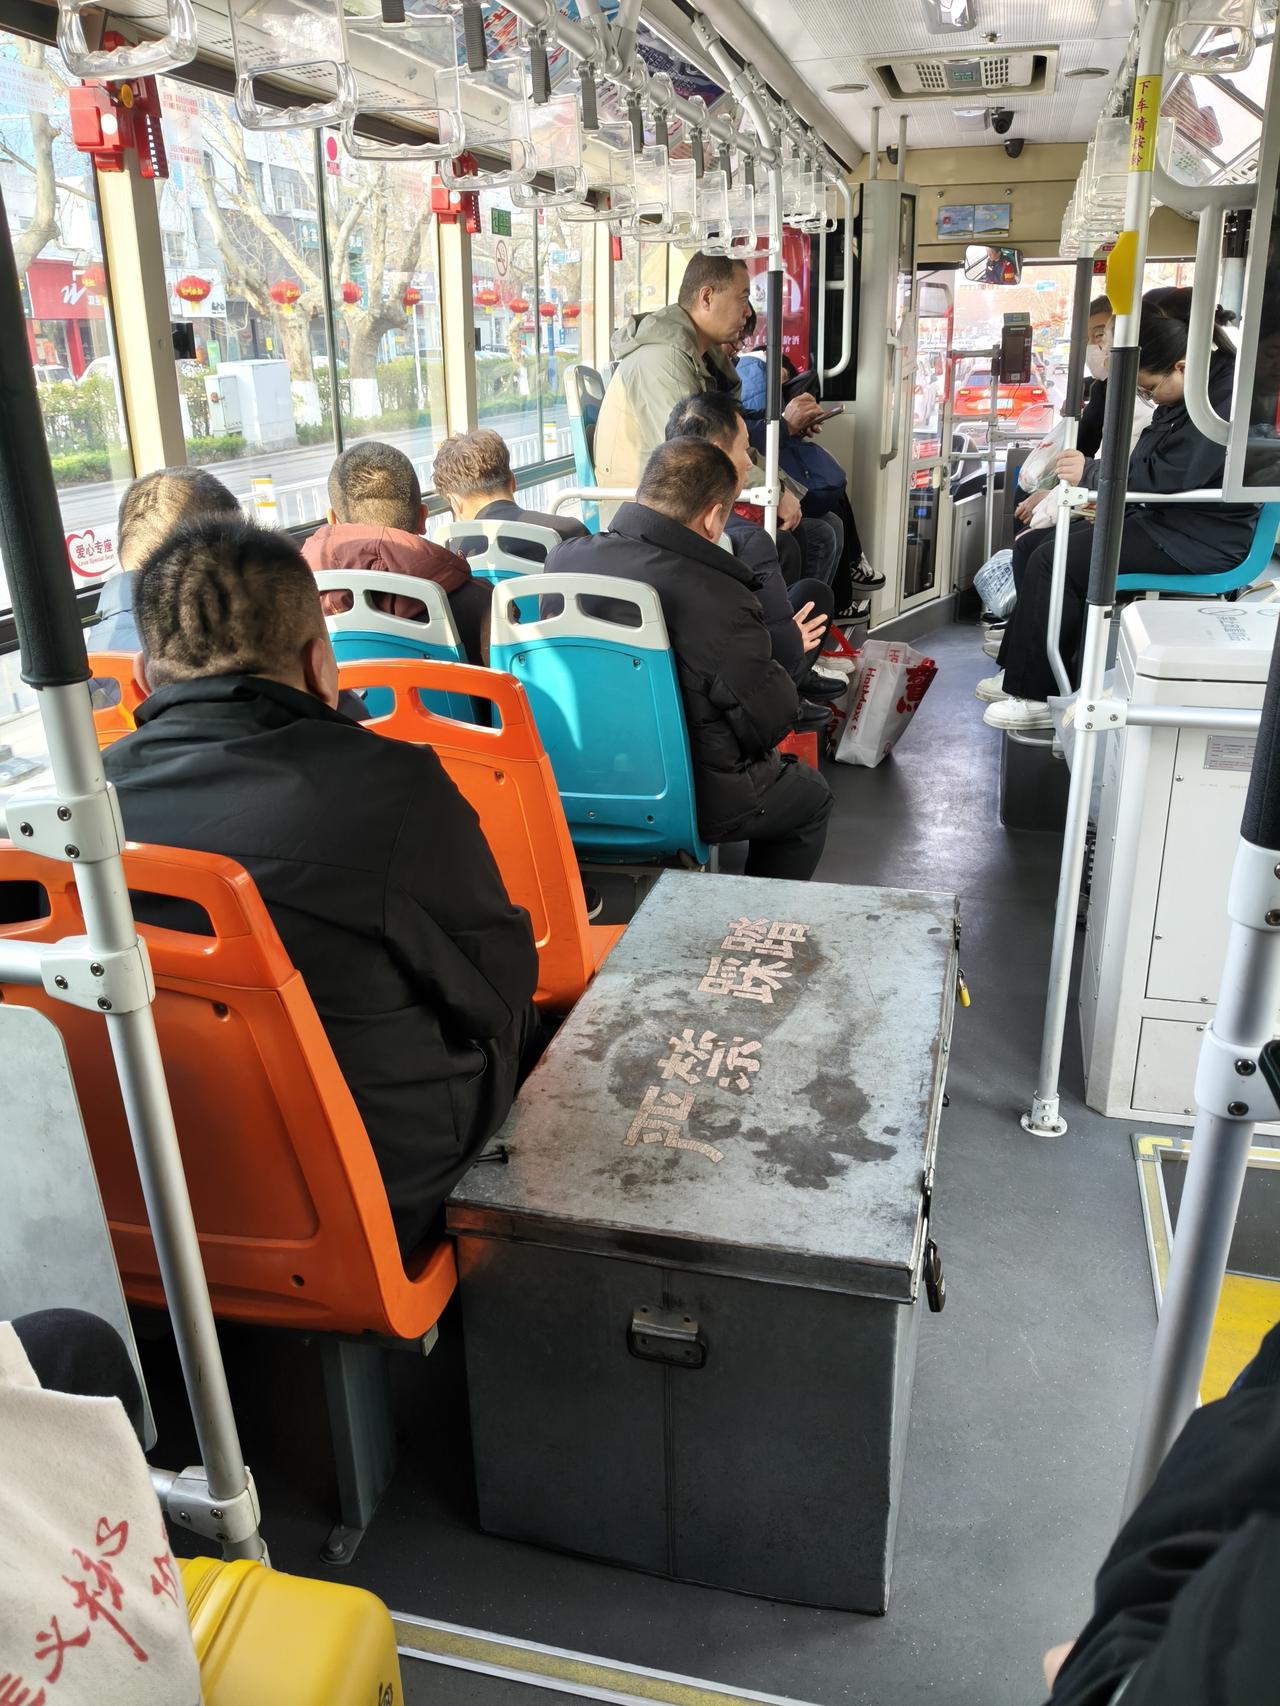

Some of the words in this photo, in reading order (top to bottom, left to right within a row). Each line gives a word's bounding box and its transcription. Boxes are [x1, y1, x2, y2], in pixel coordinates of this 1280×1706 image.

[1130, 80, 1152, 167] 下车请按铃
[75, 538, 113, 560] 爱心专座
[623, 915, 811, 1163] 严禁踩踏
